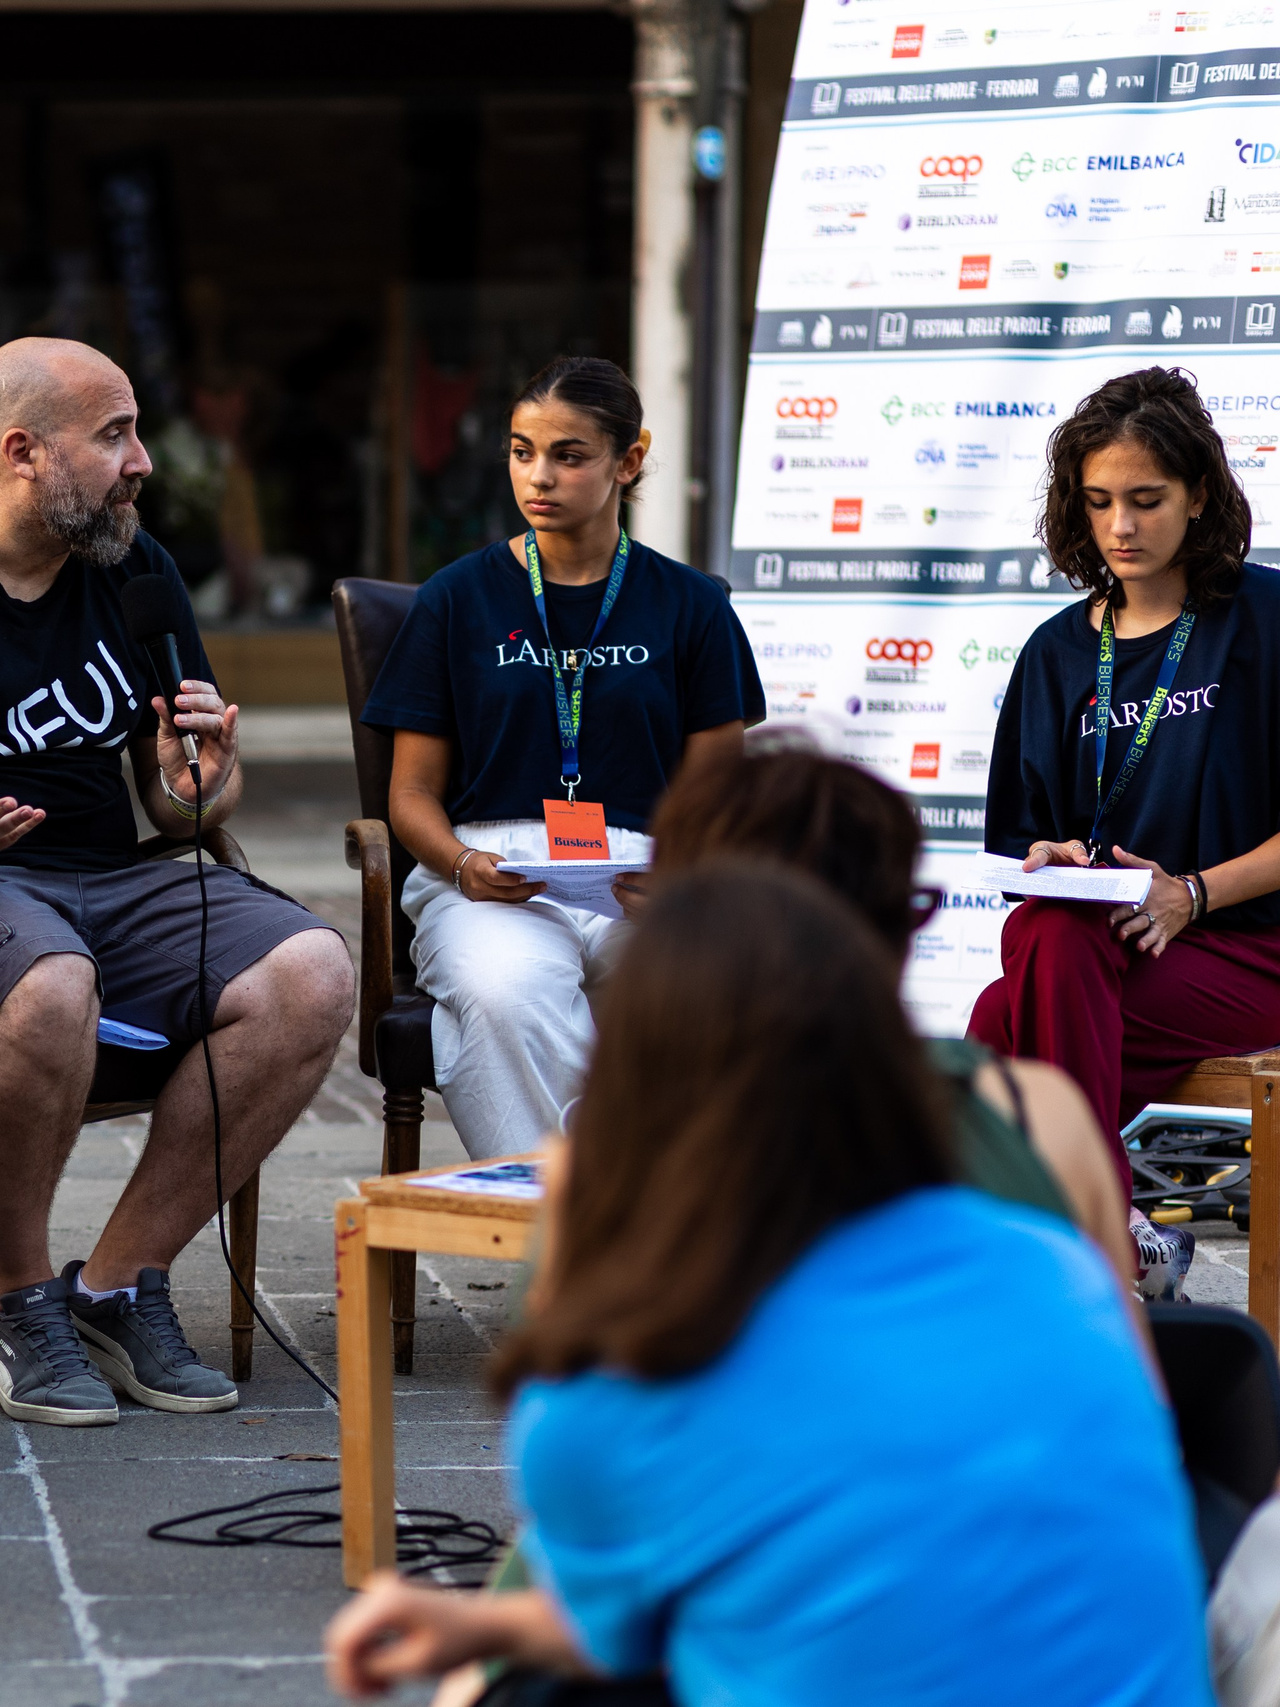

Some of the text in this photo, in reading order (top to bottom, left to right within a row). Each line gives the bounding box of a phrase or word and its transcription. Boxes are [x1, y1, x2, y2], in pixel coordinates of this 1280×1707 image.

[1204, 62, 1280, 83] FESTIVAL DEL
[845, 86, 897, 106] FESTIVAL
[898, 84, 933, 103] DELLE
[933, 82, 978, 101] PAROLE
[986, 78, 1039, 98] FERRARA
[920, 155, 983, 182] coop
[1042, 152, 1185, 172] BCC EMILBANCA
[1045, 203, 1078, 219] CNA
[912, 317, 965, 338] FESTIVAL
[966, 316, 1002, 337] DELLE
[1003, 315, 1052, 336] PAROLE
[1061, 314, 1111, 336] FERRARA
[776, 397, 838, 425] coop
[955, 401, 1056, 418] EMILBANCA
[1207, 396, 1280, 411] BEIPRO
[527, 543, 543, 597] BuskerS
[788, 560, 839, 581] FESTIVAL
[840, 560, 874, 581] DELLE
[876, 560, 921, 582] PAROLE
[931, 561, 986, 582] FERRARA
[866, 637, 933, 667] coop
[1097, 665, 1111, 737] BUSKERS
[556, 681, 575, 749] BUSKERS
[1103, 686, 1169, 814] BuskerS BUSKERS
[554, 836, 603, 848] BuskerS
[26, 1293, 44, 1304] PUMA
[0, 1338, 14, 1356] PUMA
